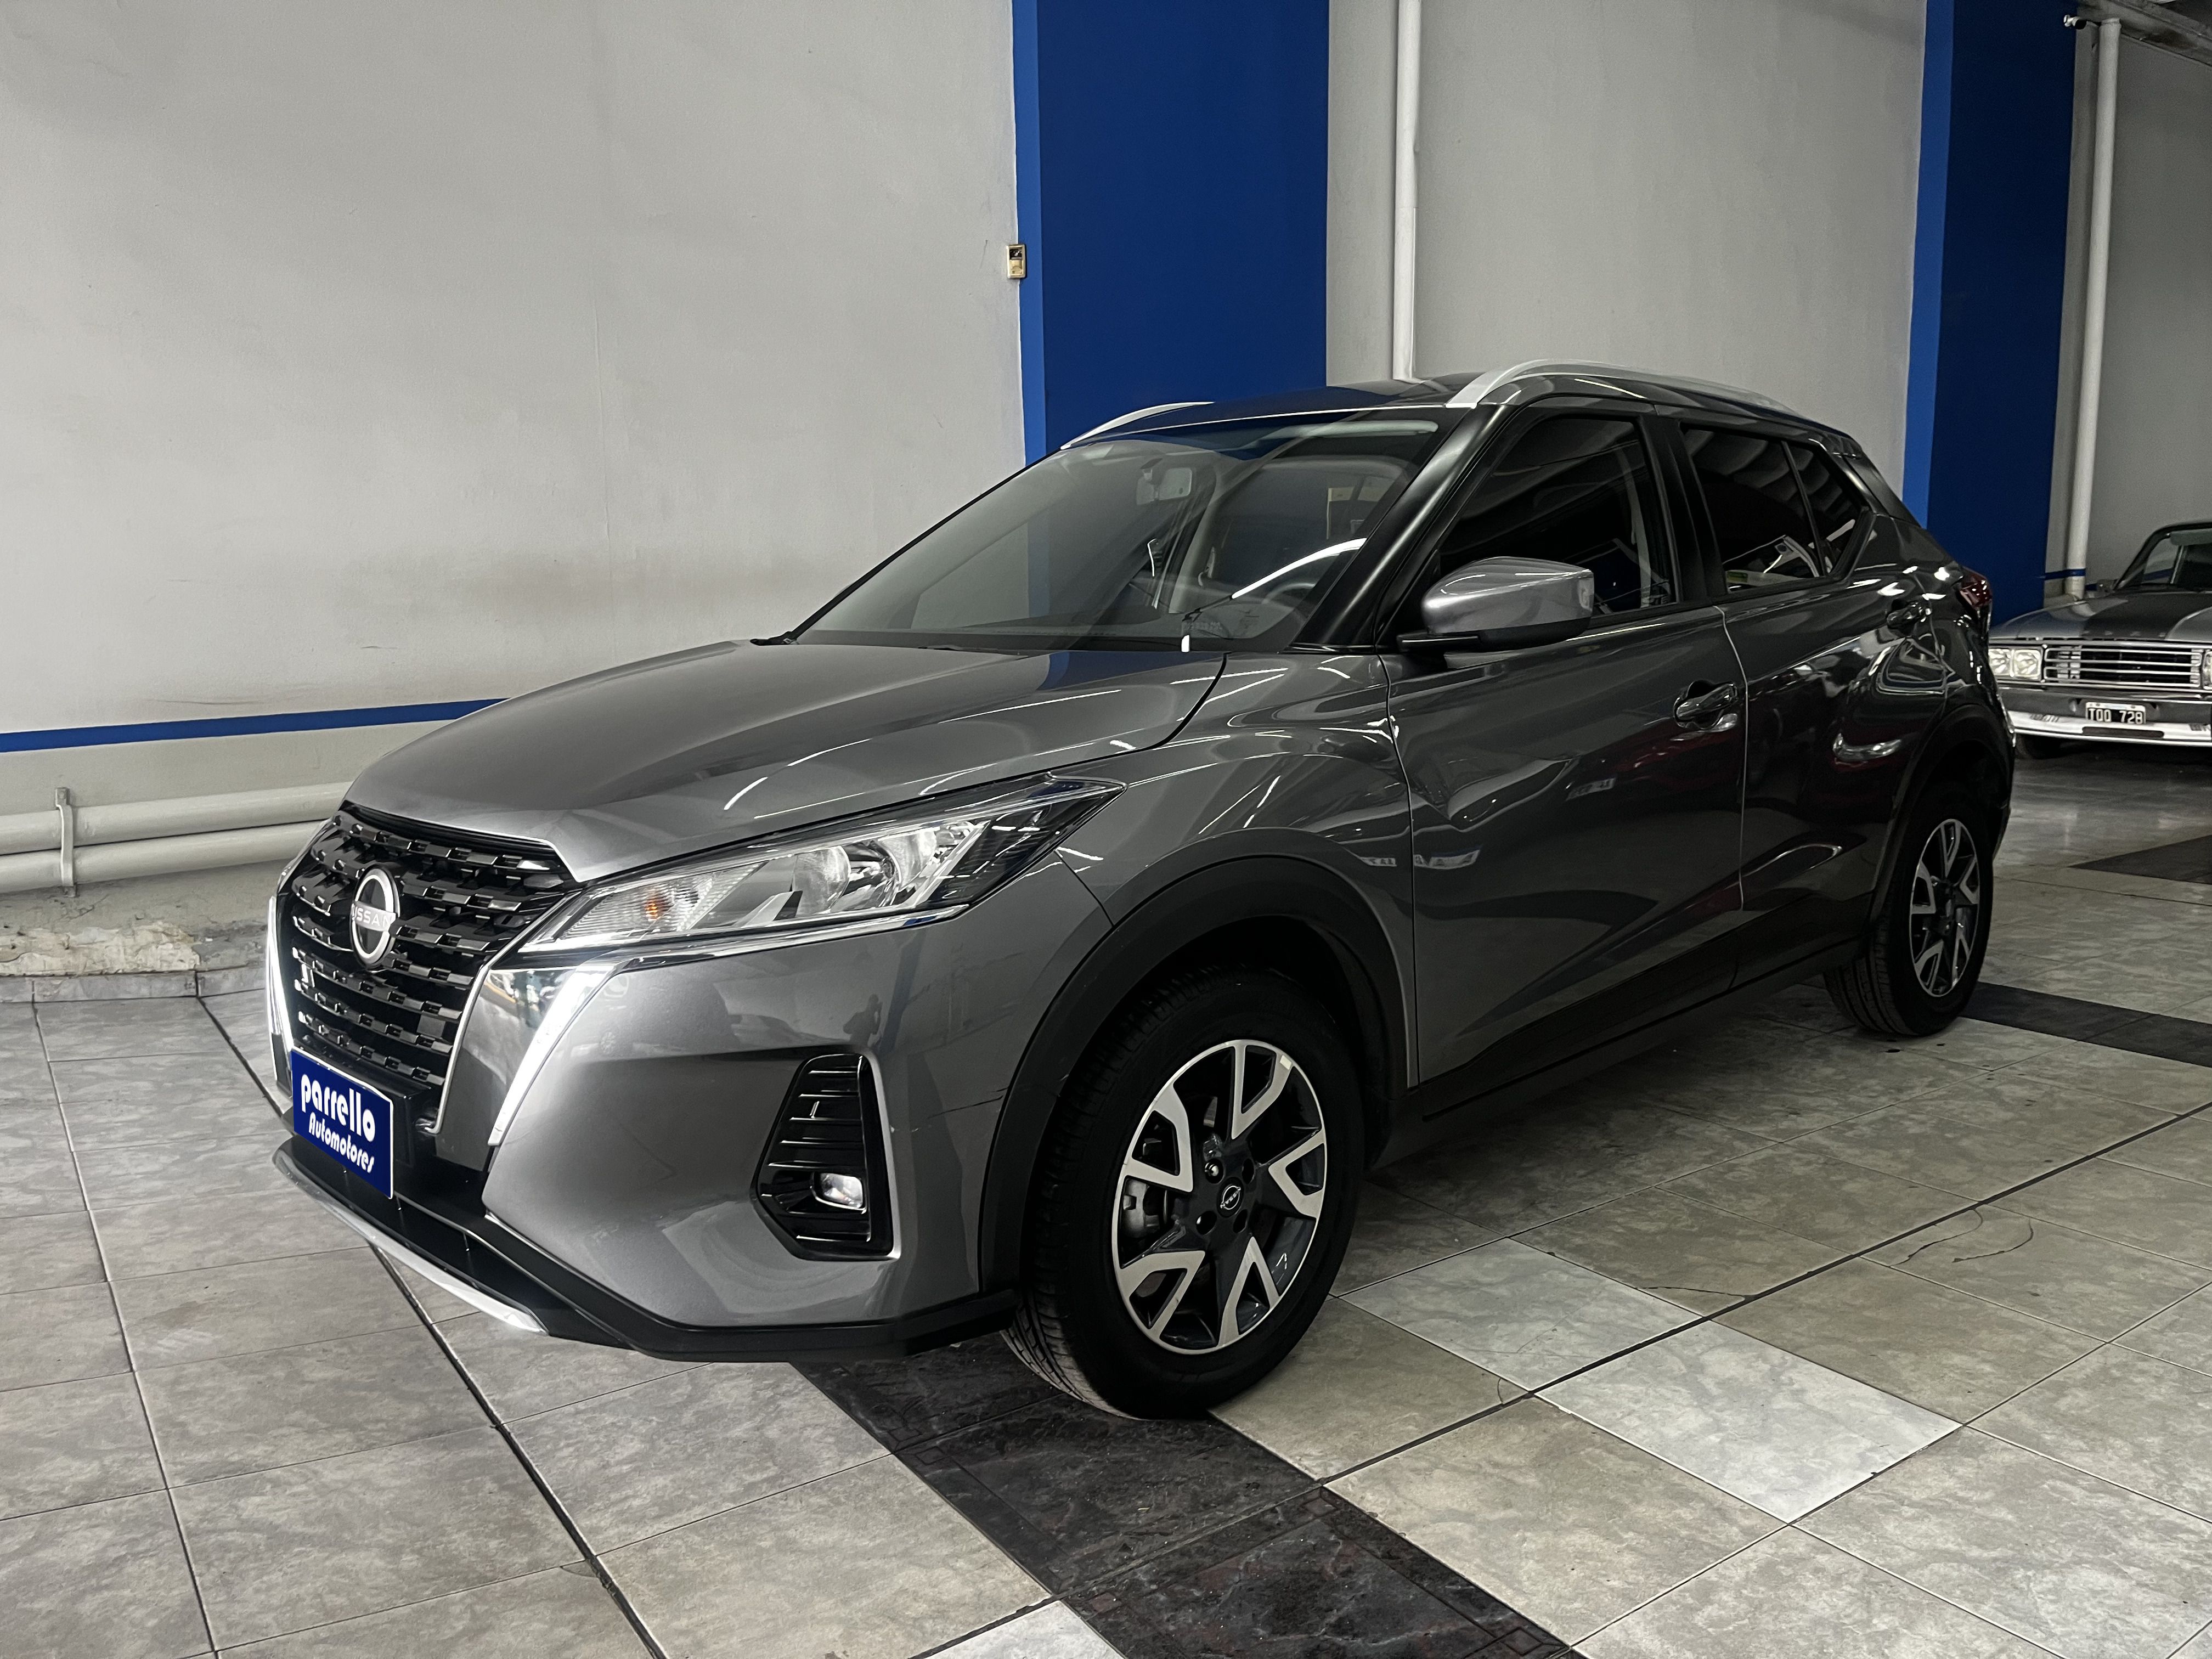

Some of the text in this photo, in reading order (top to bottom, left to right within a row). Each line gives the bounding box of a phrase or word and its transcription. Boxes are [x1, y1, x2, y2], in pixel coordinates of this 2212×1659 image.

[2119, 710, 2143, 725] 728
[301, 1074, 375, 1142] parrello
[308, 1111, 375, 1173] Automotores
